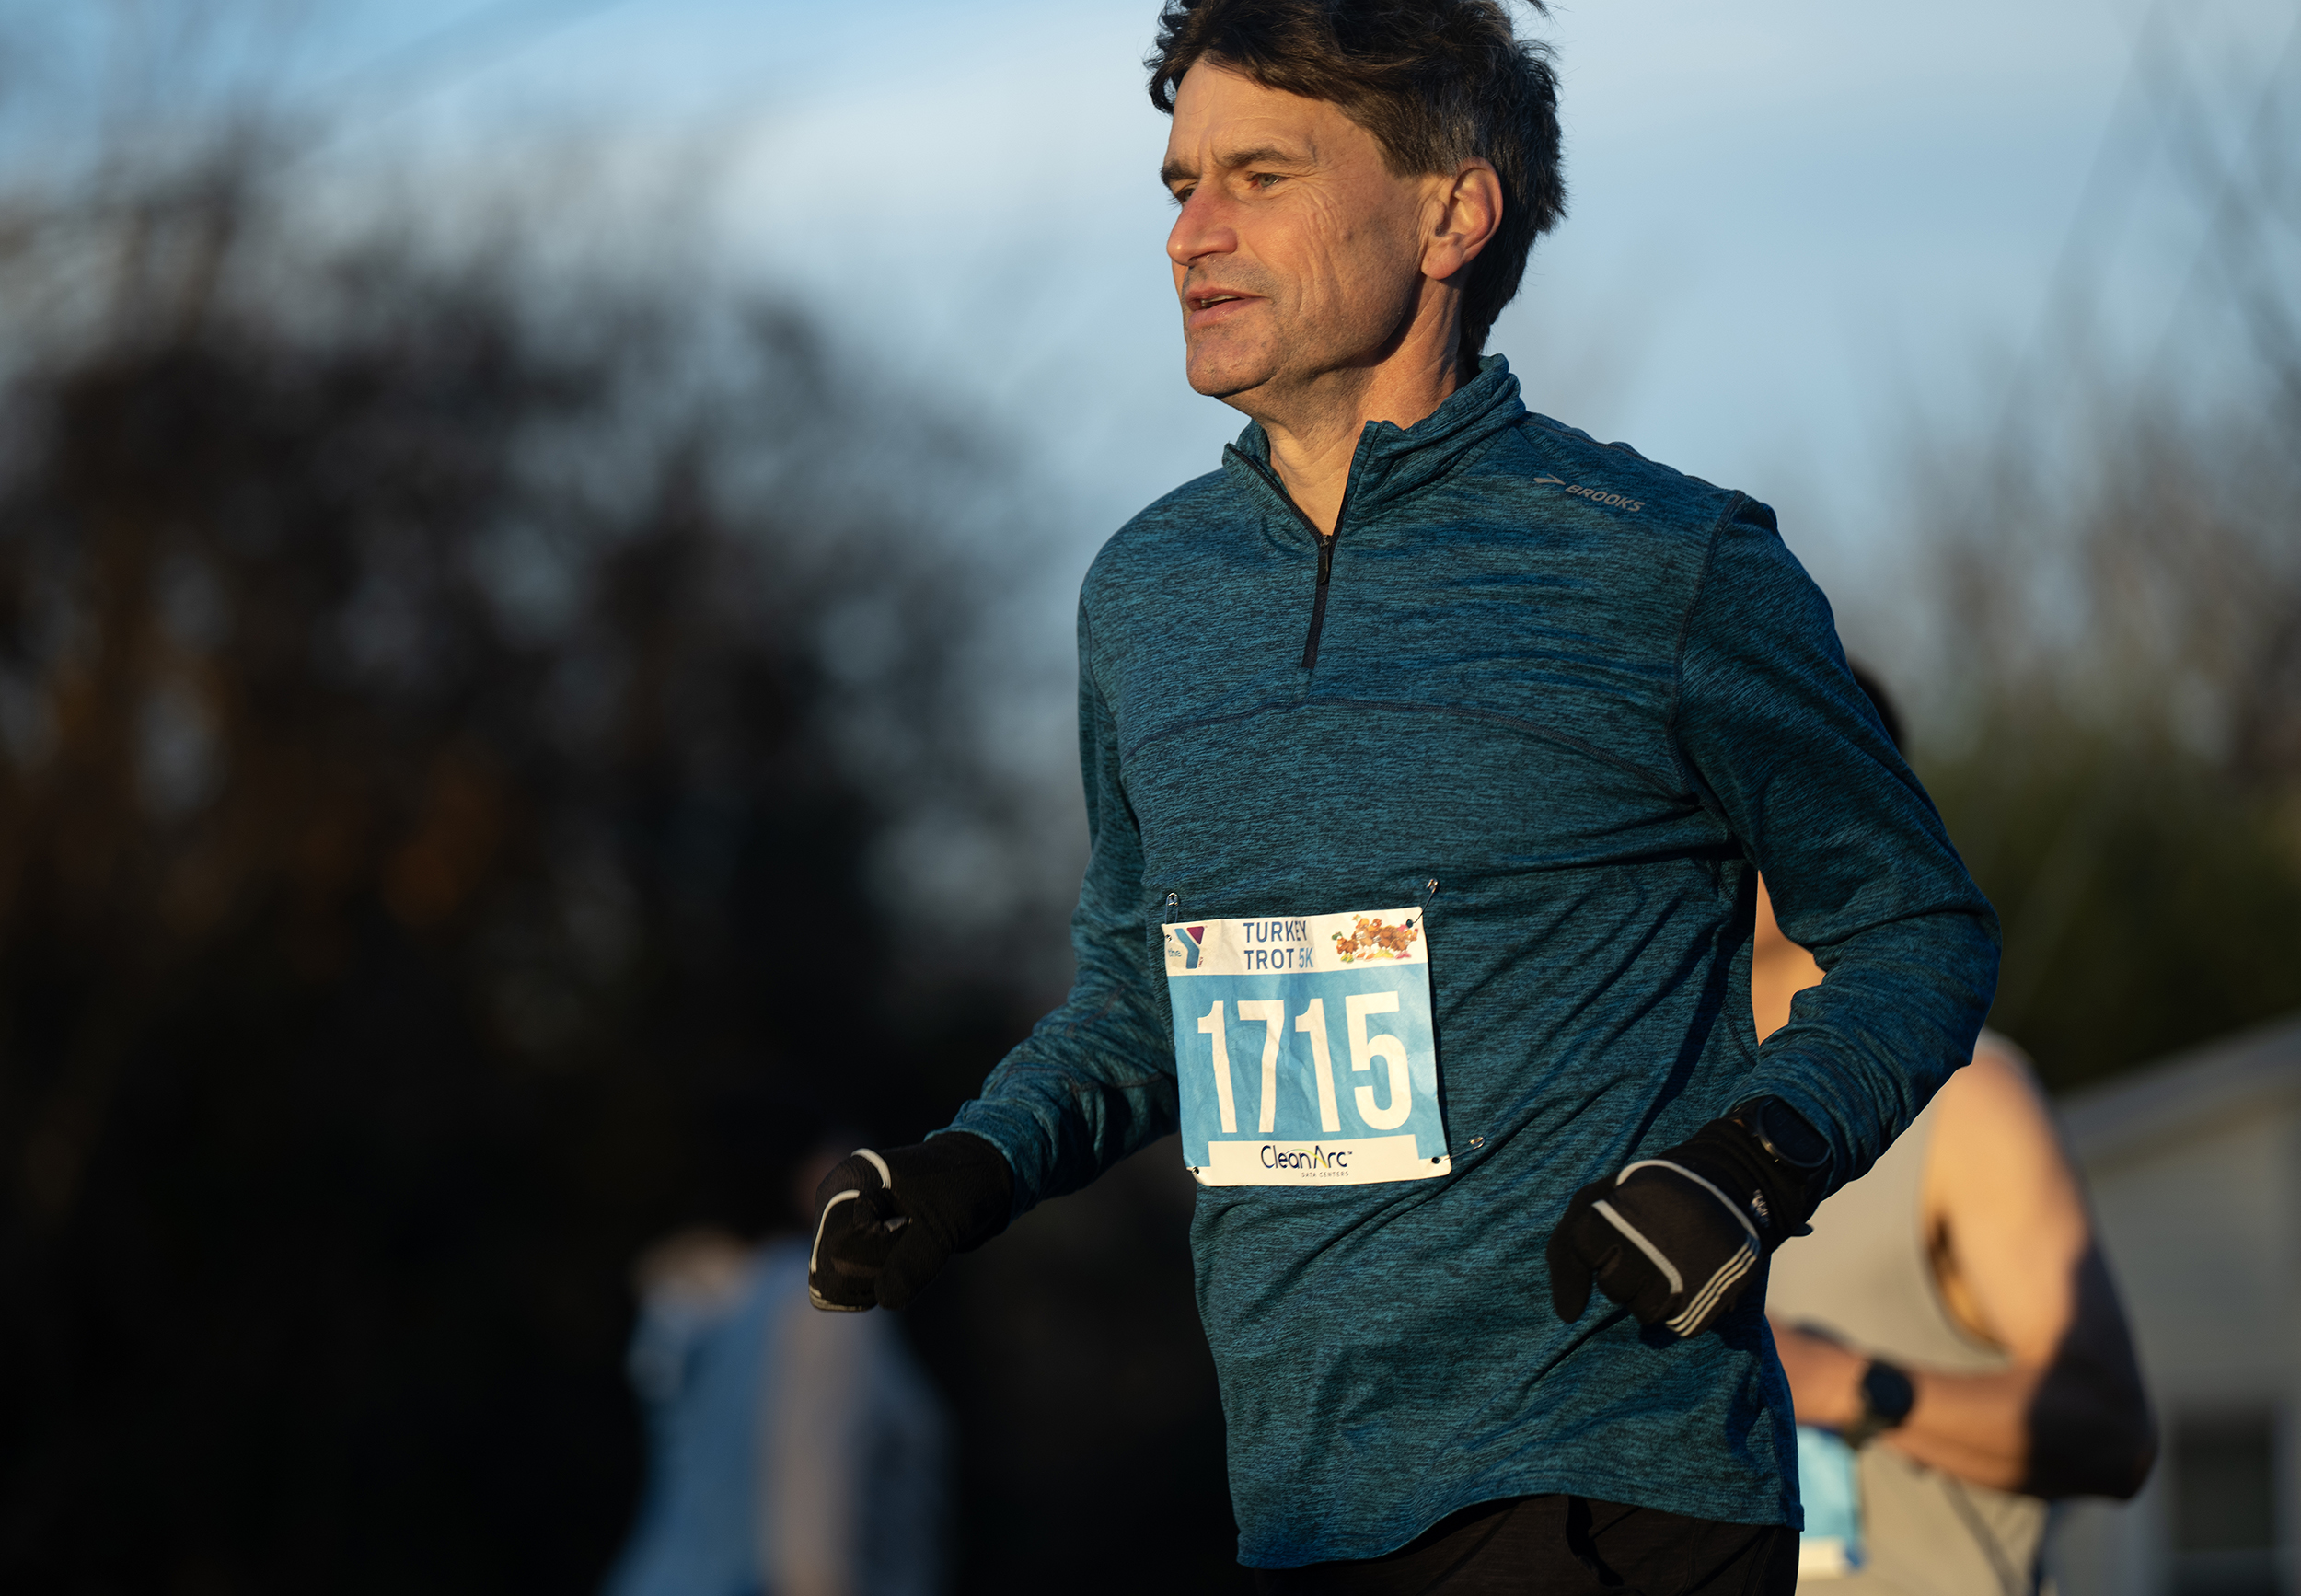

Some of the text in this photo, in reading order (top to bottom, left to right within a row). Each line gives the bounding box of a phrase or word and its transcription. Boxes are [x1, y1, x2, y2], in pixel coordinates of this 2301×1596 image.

[1565, 484, 1646, 513] BROOKS
[1243, 920, 1307, 943] TURKEY
[1167, 947, 1182, 958] the
[1243, 947, 1313, 970] TROT 5K
[1197, 990, 1413, 1134] 1715
